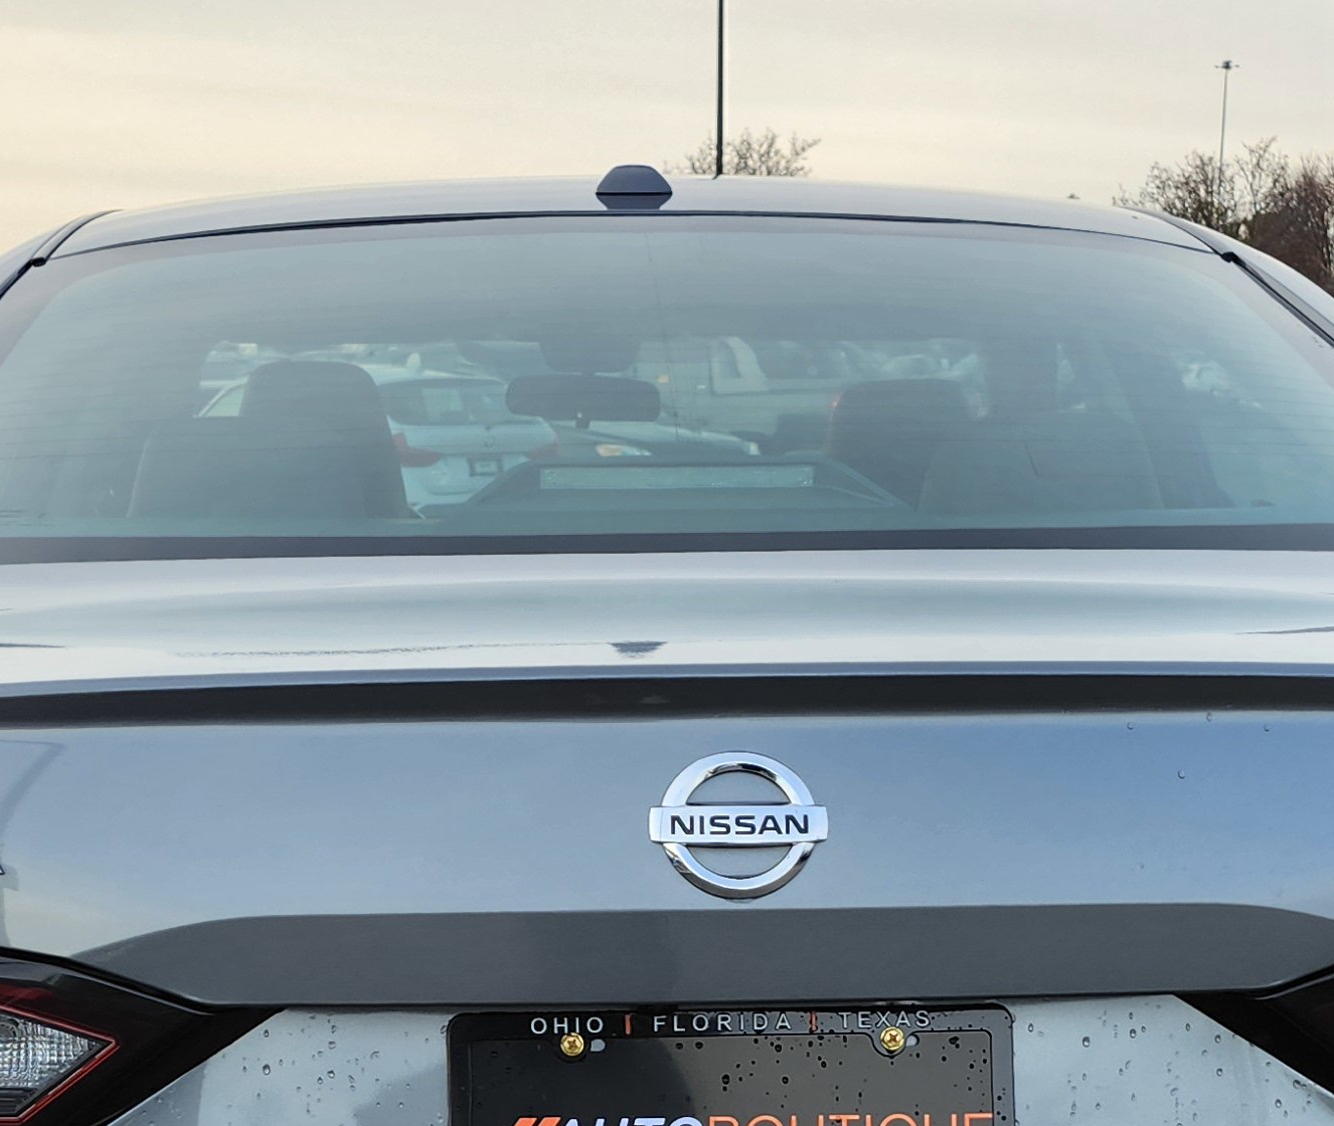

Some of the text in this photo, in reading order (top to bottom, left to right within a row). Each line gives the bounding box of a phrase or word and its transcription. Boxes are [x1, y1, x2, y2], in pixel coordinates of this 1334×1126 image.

[670, 814, 809, 836] NISSAN
[530, 1009, 931, 1035] OHIO FLORIDA TEXAS
